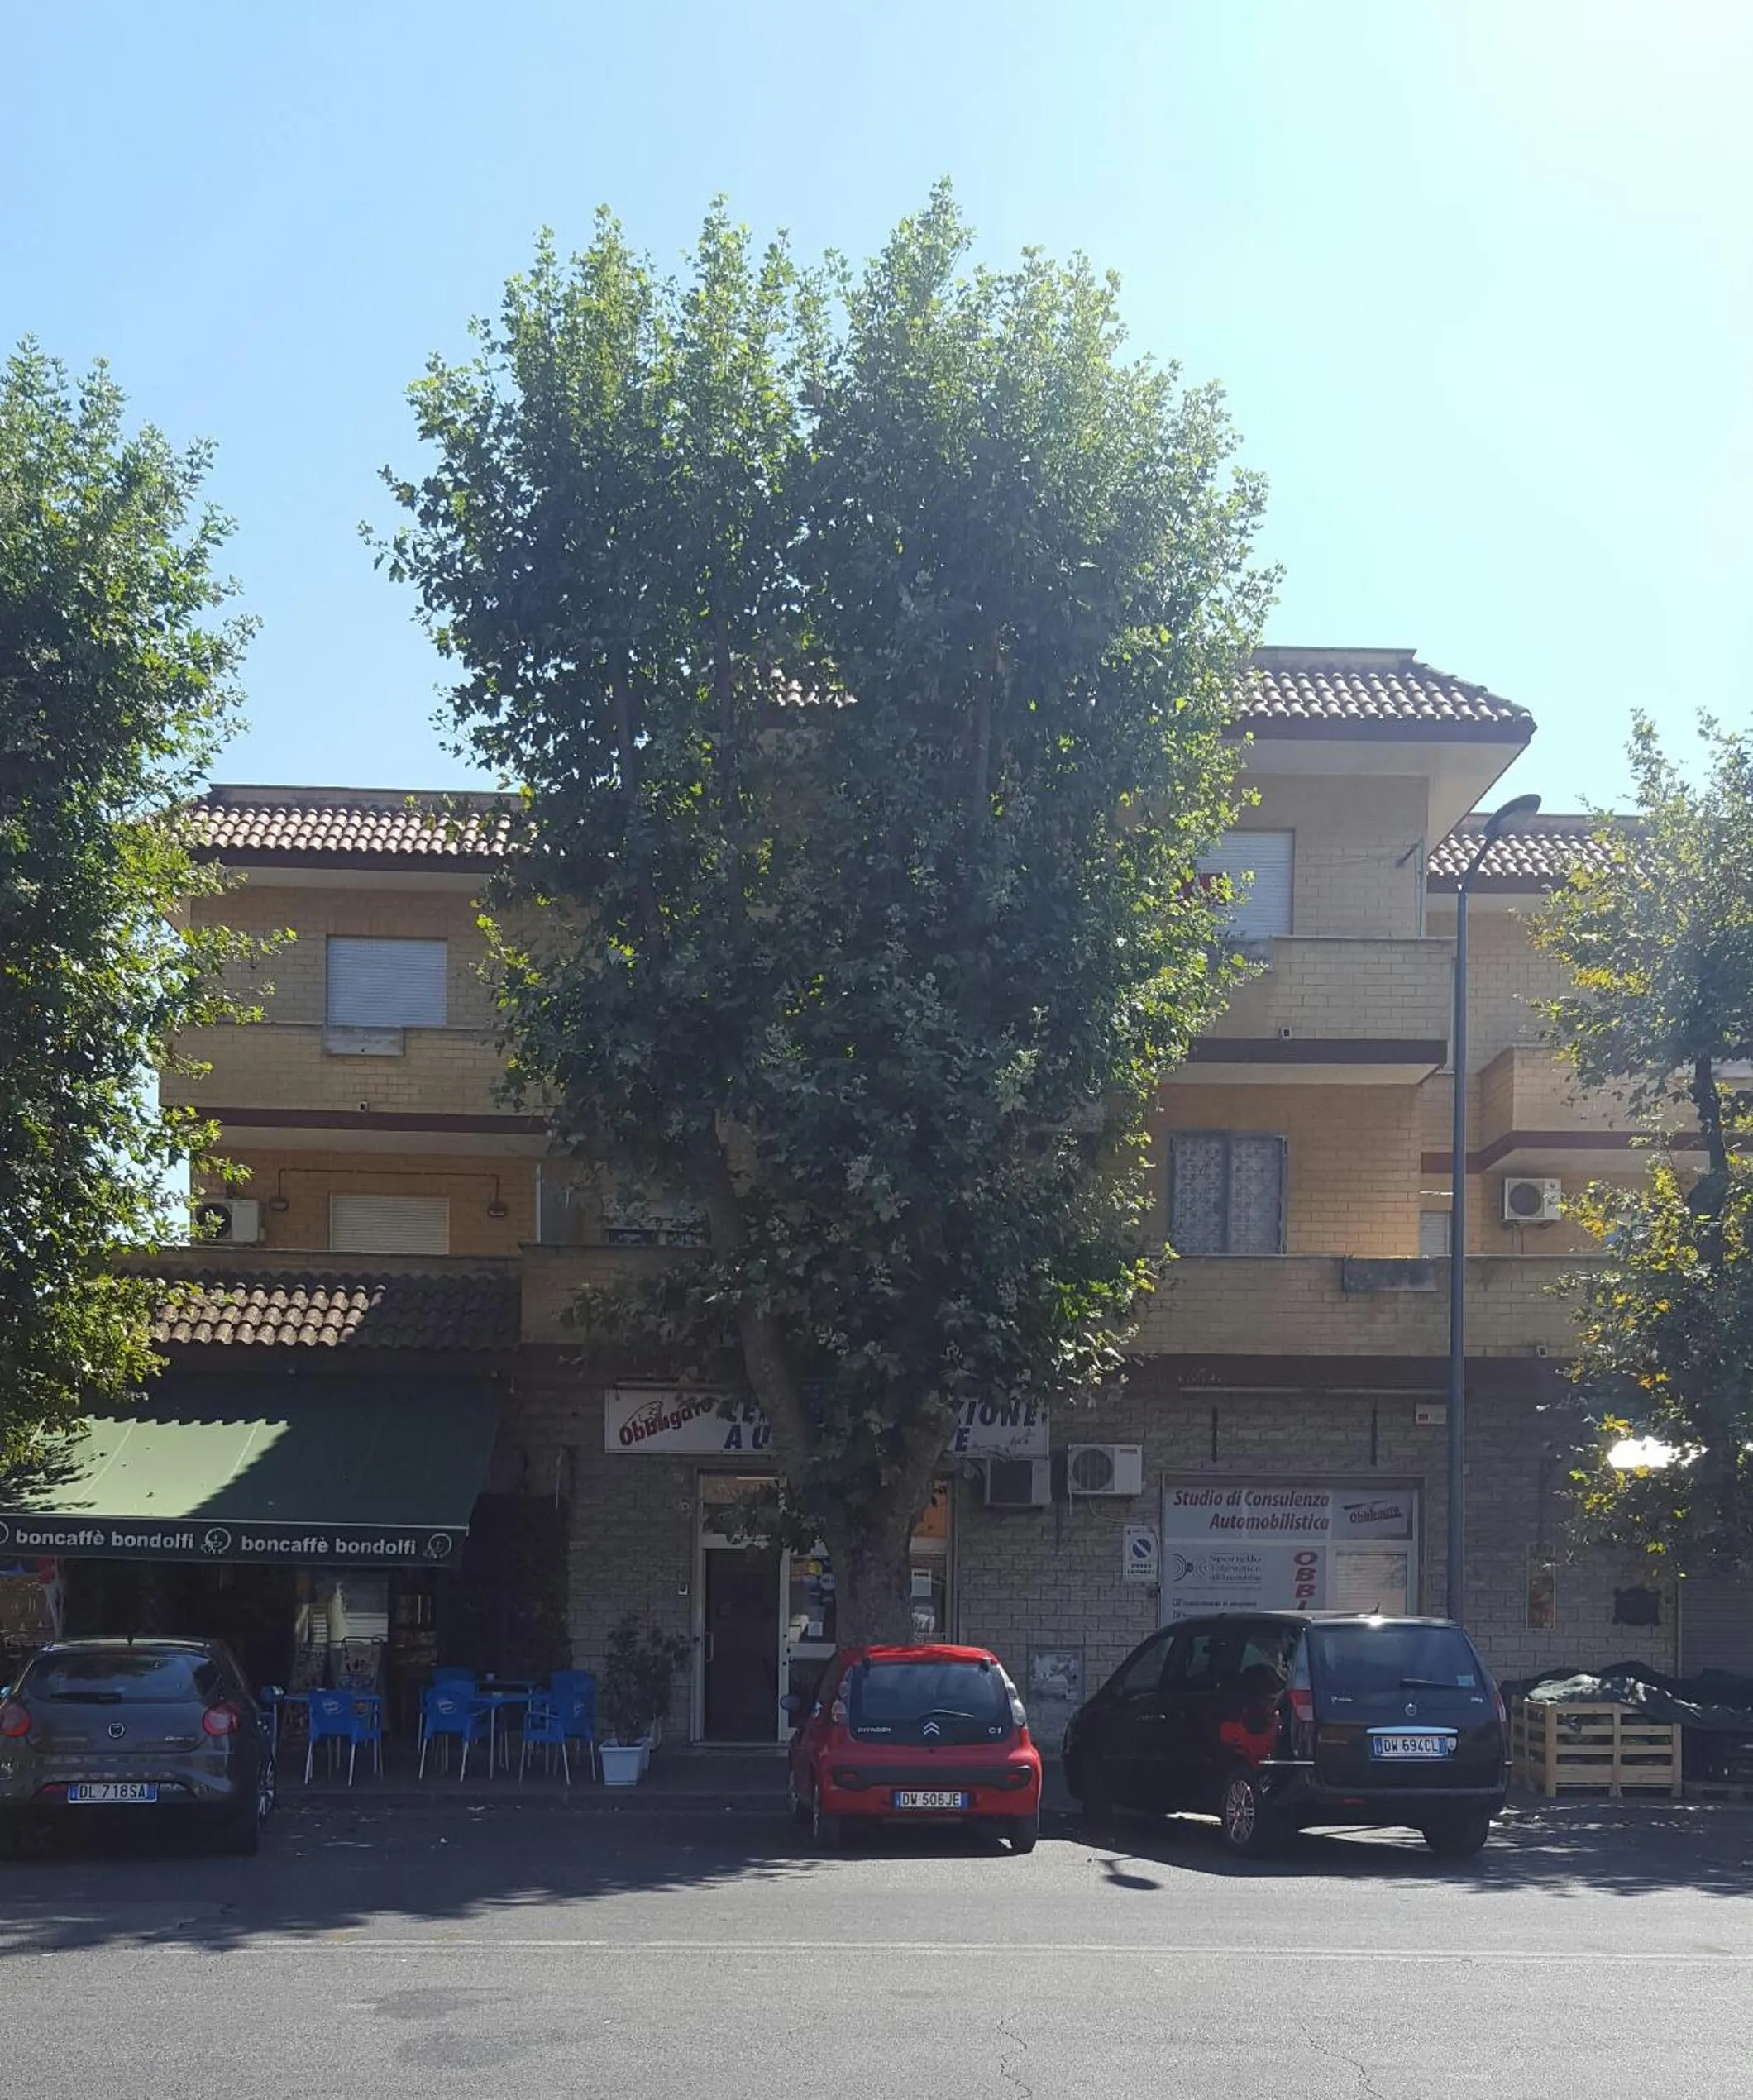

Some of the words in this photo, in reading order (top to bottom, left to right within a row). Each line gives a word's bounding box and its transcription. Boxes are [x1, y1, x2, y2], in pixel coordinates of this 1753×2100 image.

[1173, 1490, 1223, 1506] Studio
[1226, 1490, 1241, 1506] di
[1244, 1490, 1330, 1507] Consulenza
[1209, 1513, 1330, 1530] Automobilistica
[16, 1529, 105, 1546] boncaffè
[112, 1530, 194, 1549] bondolfi
[241, 1535, 329, 1554] boncaffè
[335, 1538, 416, 1555] bondolfi
